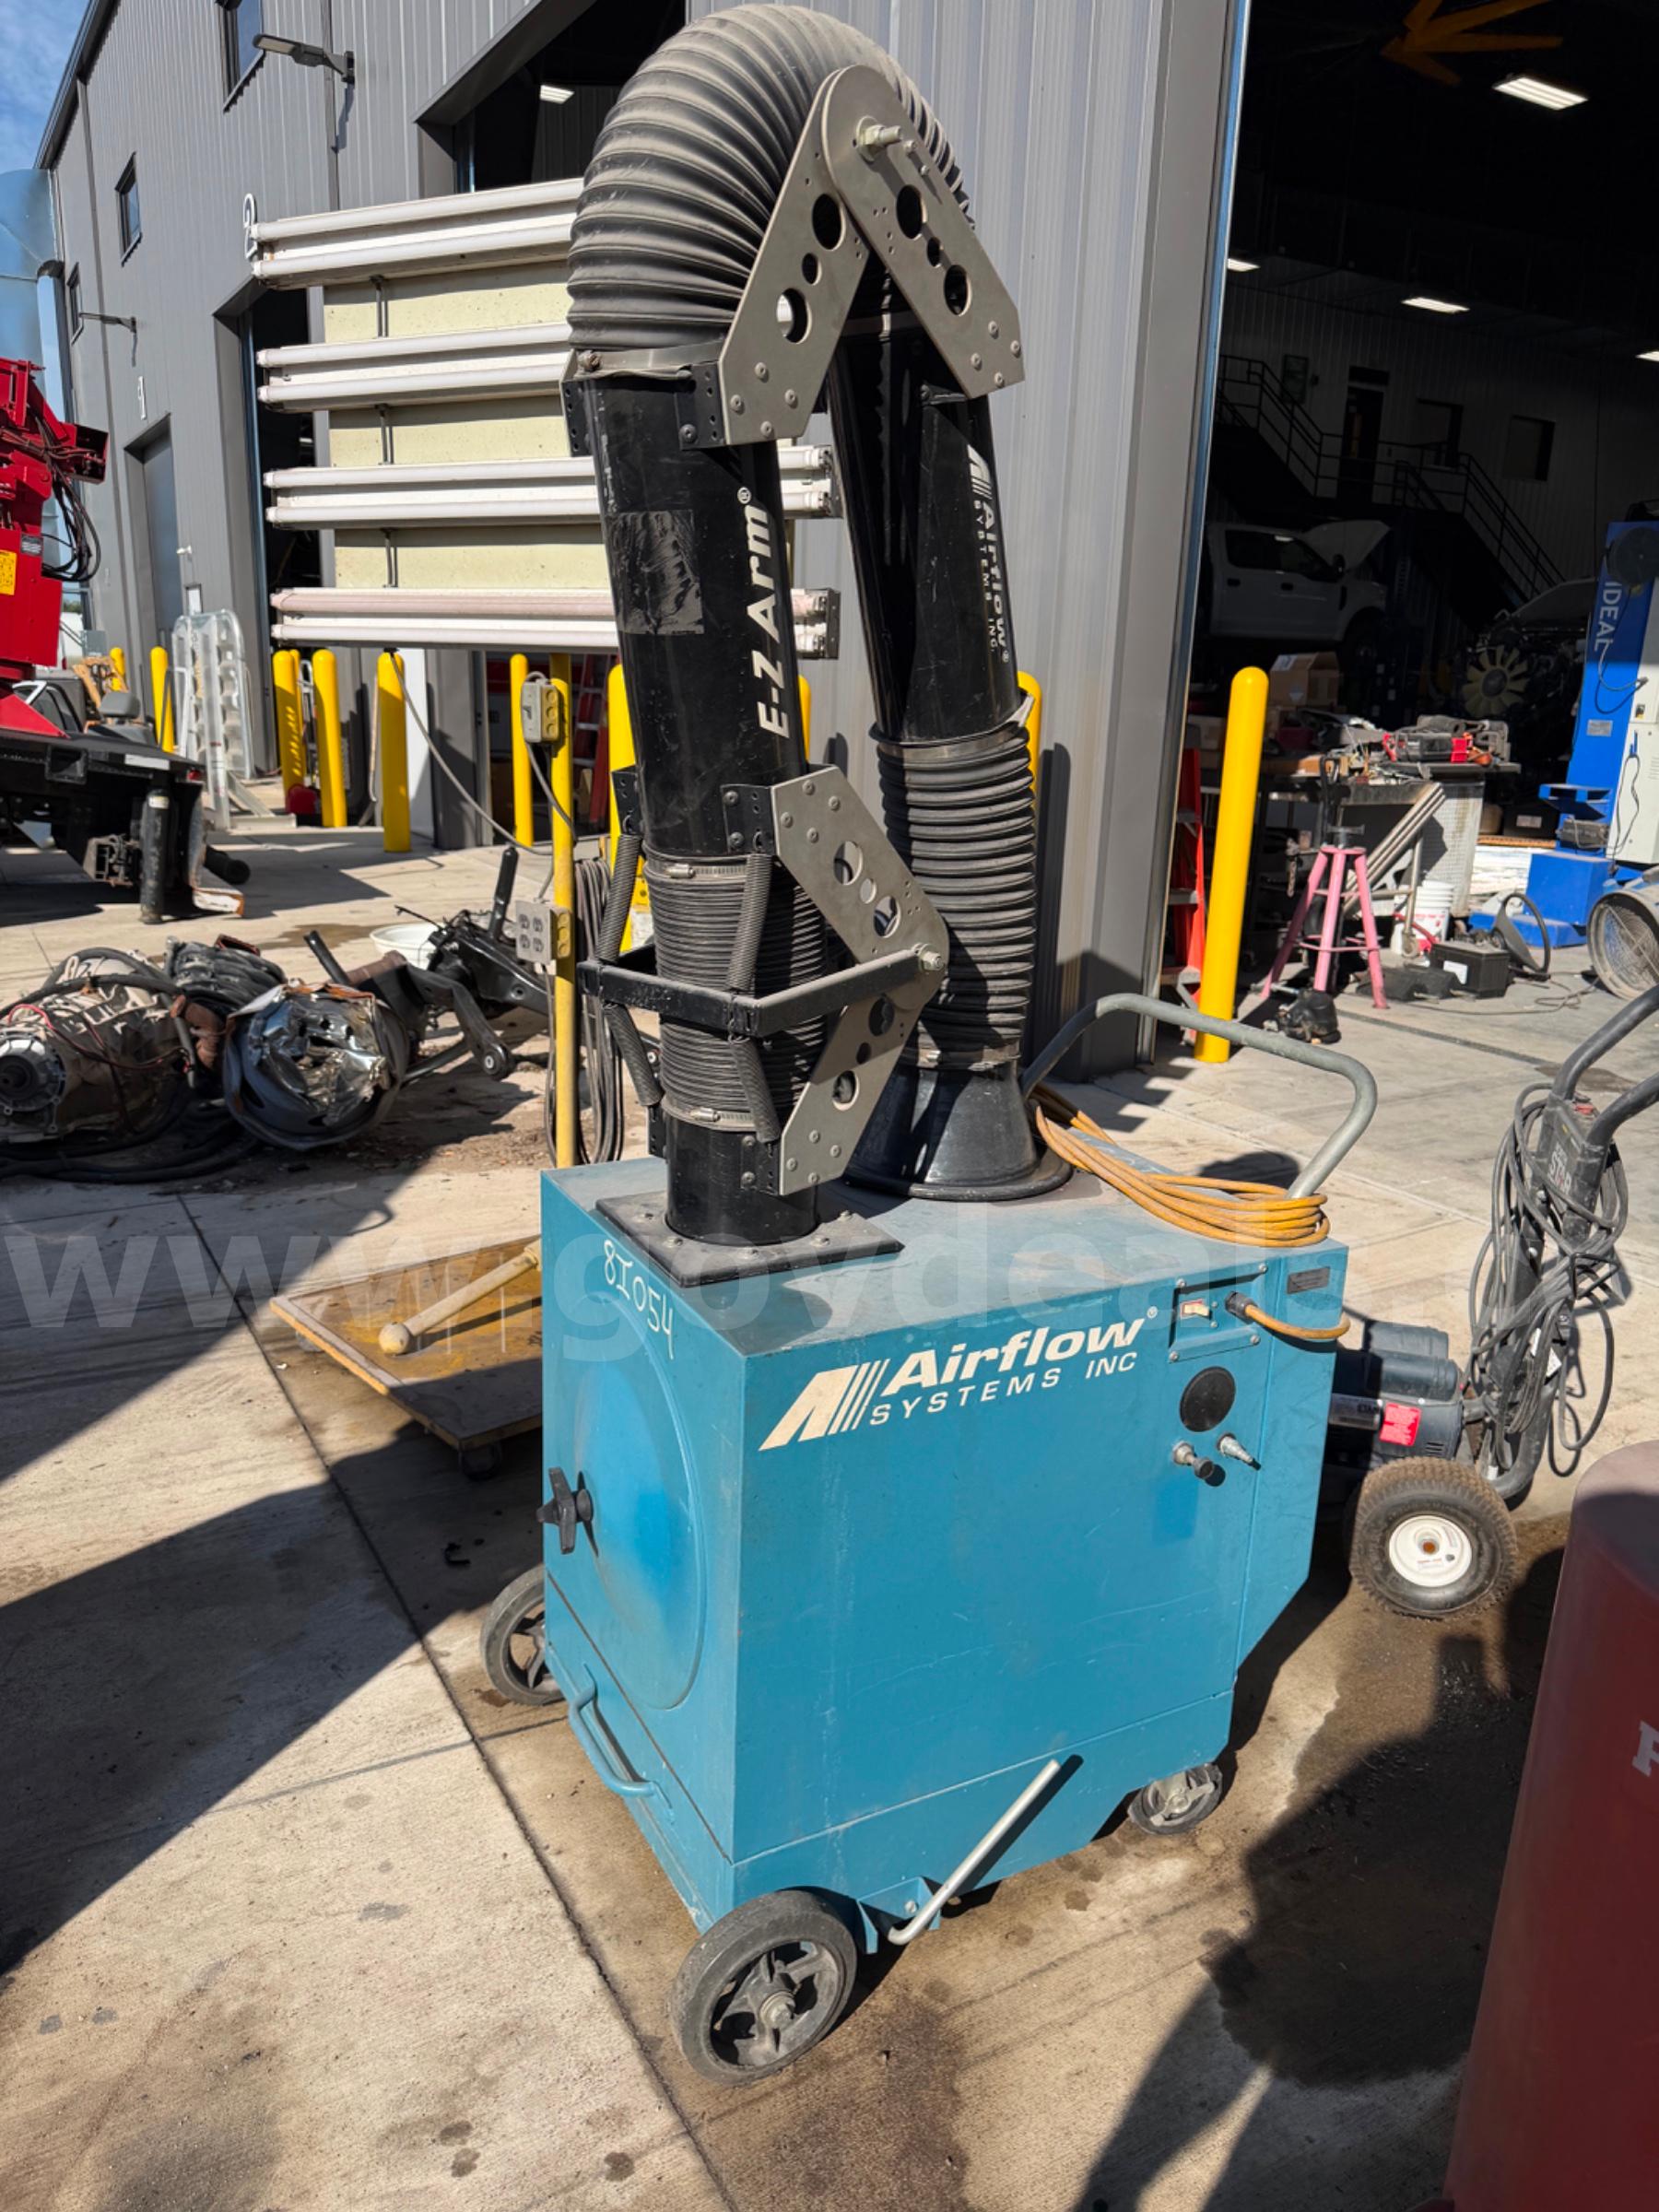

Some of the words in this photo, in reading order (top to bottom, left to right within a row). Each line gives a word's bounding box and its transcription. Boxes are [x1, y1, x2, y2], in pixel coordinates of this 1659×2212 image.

[1594, 582, 1623, 652] IDEAL
[752, 649, 790, 738] E-Z
[870, 1367, 1062, 1427] SYSTEMS
[1085, 1351, 1138, 1381] INC
